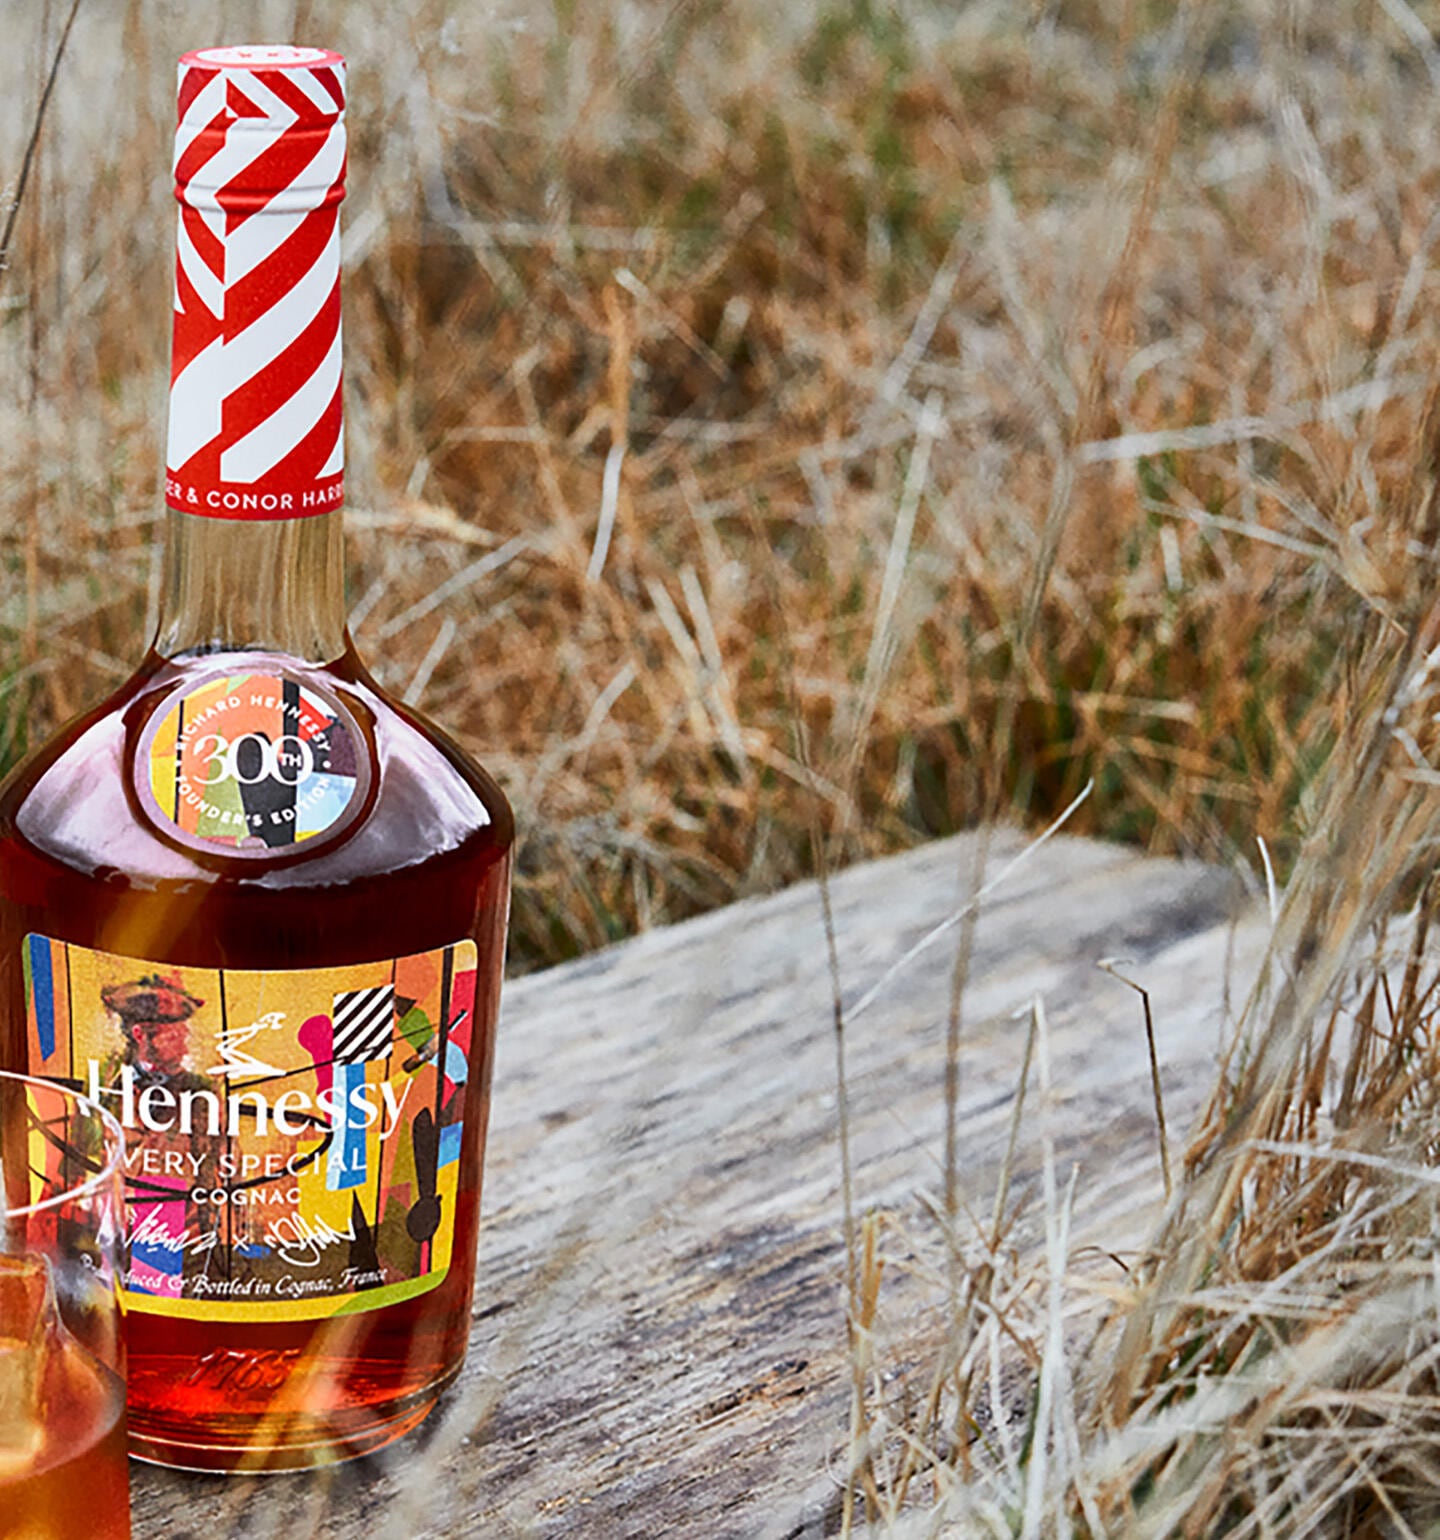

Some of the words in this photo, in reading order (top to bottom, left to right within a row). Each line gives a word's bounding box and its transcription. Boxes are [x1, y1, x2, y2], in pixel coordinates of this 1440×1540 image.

[186, 486, 199, 504] &
[206, 490, 293, 510] CONOR
[175, 696, 241, 750] RICHARD
[250, 695, 331, 751] HENNESSY
[175, 774, 263, 827] FOUNDER'S
[270, 777, 330, 825] EDITION
[79, 1059, 413, 1141] Hennessy
[218, 1147, 368, 1178] SPECIAL
[190, 1186, 302, 1206] COGNAC
[192, 1273, 256, 1294] Bottled
[255, 1280, 271, 1295] in
[274, 1275, 334, 1299] Cognac,
[338, 1266, 388, 1289] France
